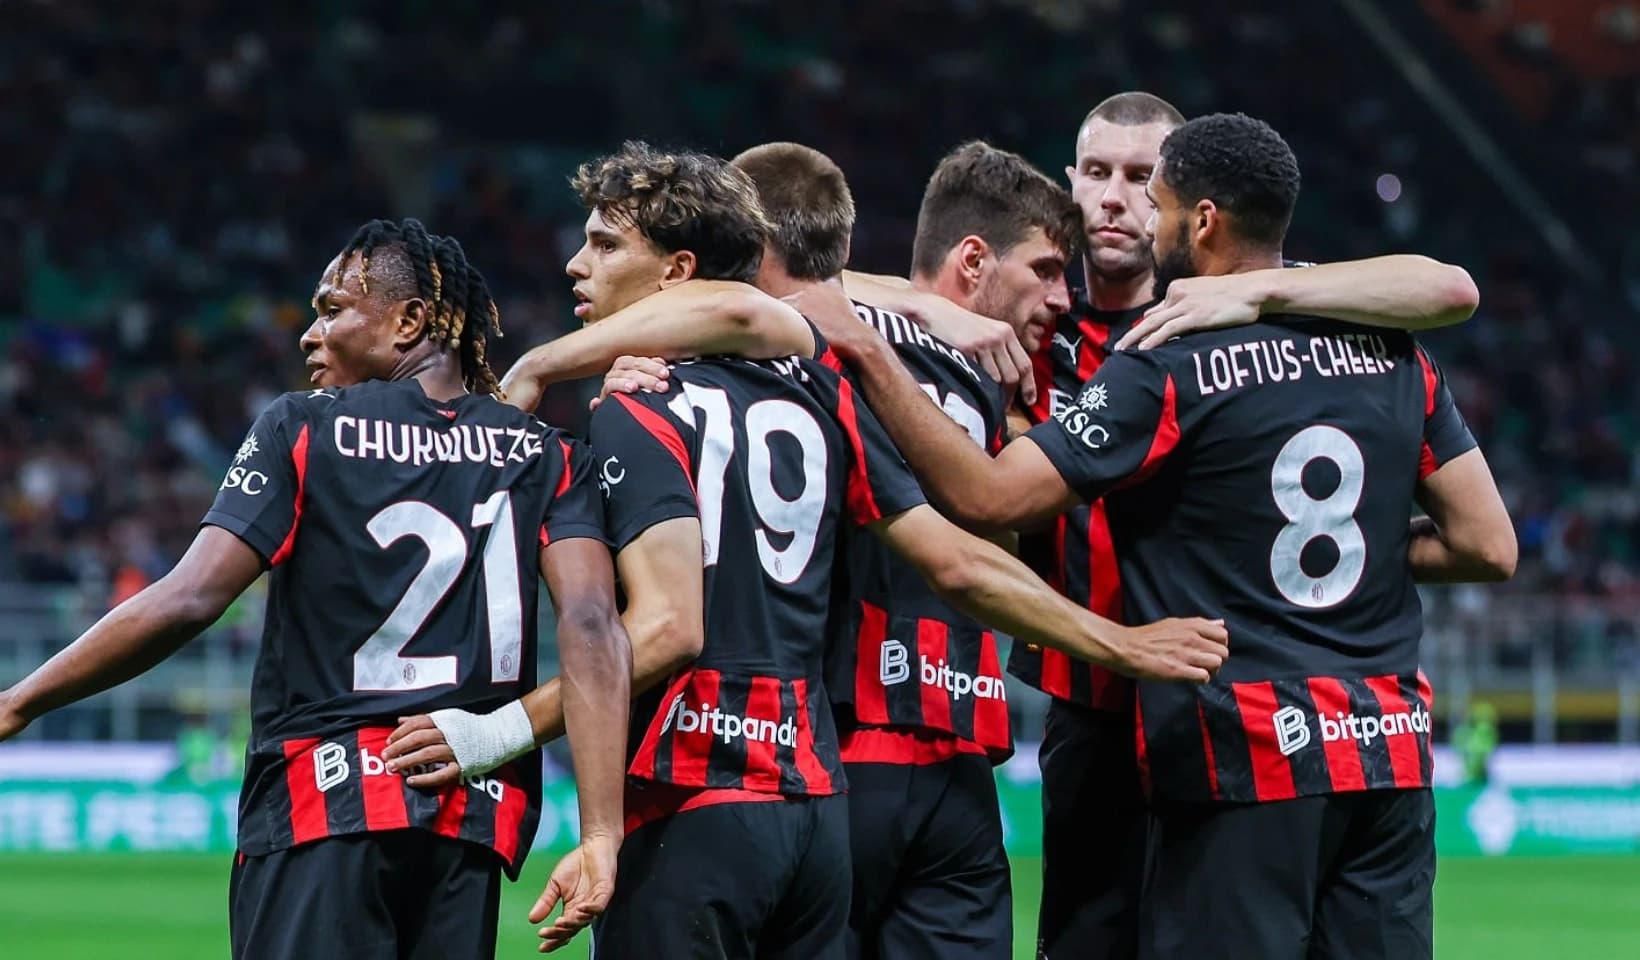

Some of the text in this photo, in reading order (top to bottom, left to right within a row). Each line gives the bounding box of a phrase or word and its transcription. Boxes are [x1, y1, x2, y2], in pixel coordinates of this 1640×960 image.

[219, 466, 269, 496] SC
[1270, 423, 1367, 609] 8
[353, 489, 522, 692] 21
